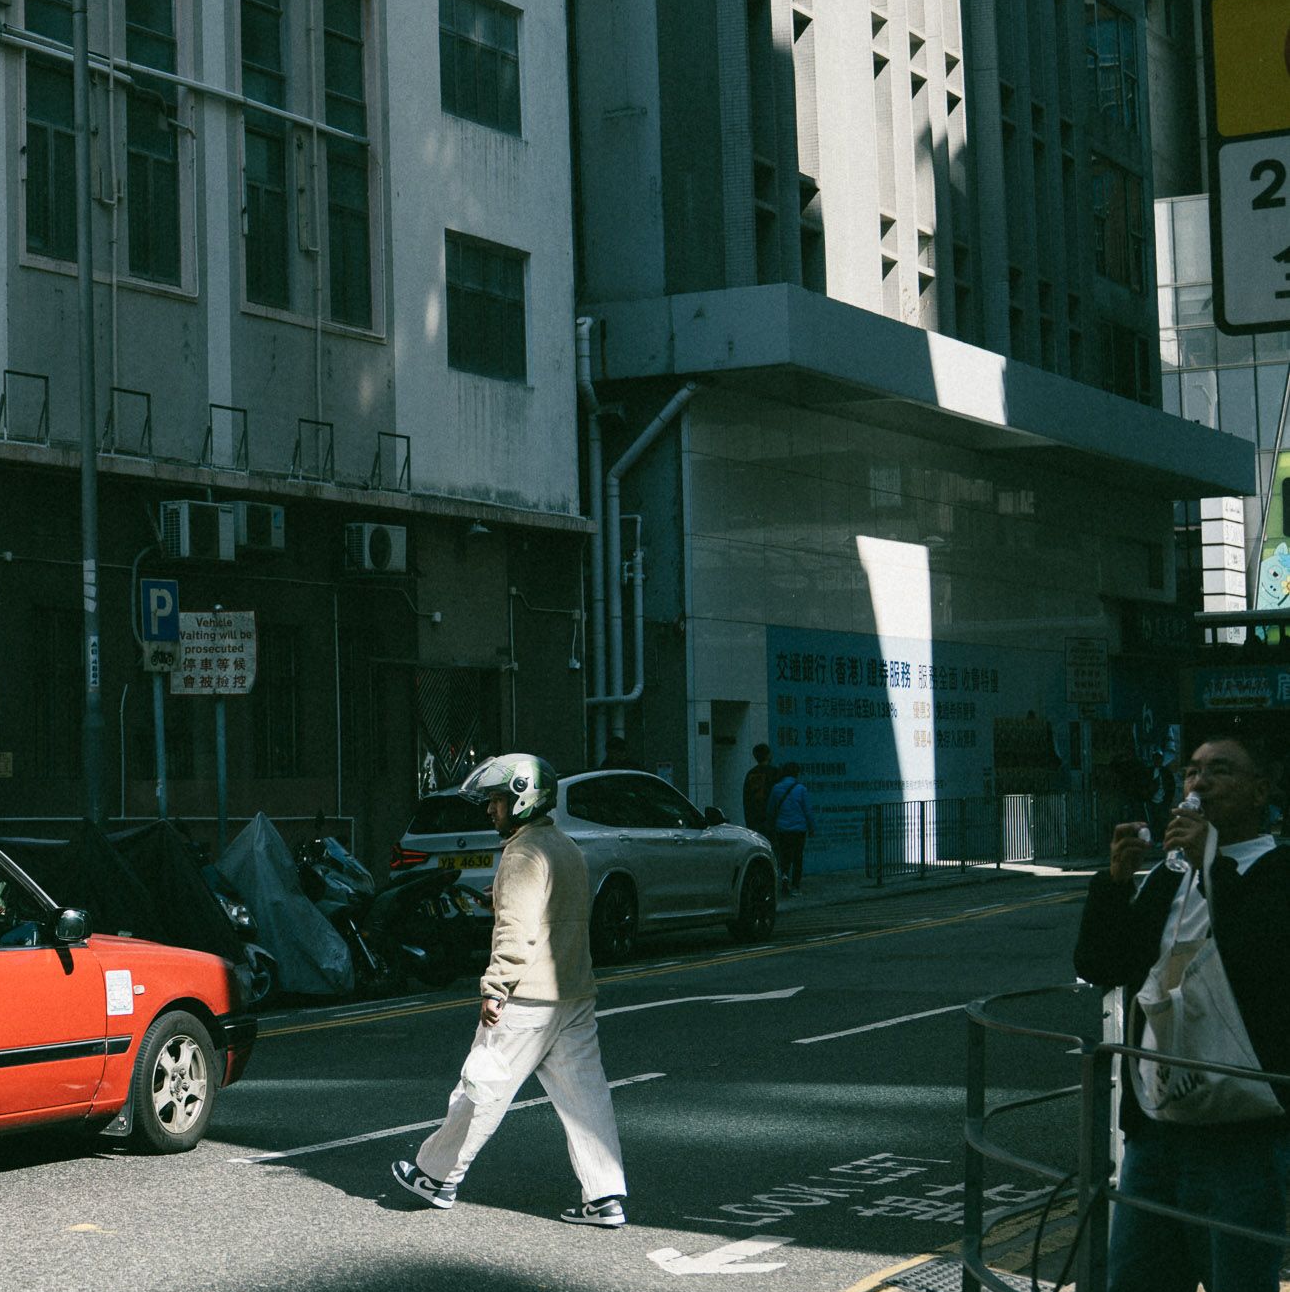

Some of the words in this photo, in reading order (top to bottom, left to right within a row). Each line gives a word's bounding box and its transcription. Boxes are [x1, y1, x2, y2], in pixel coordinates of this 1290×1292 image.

[149, 588, 173, 635] P
[196, 616, 233, 627] Vehicle
[219, 629, 238, 639] will
[240, 629, 252, 639] be
[185, 643, 244, 655] prosecuted
[182, 657, 247, 672] 停車等候
[182, 674, 247, 689] 會被檢控
[460, 855, 491, 869] 4630
[682, 1183, 864, 1226] LOOK
[808, 1152, 951, 1186] LEFT
